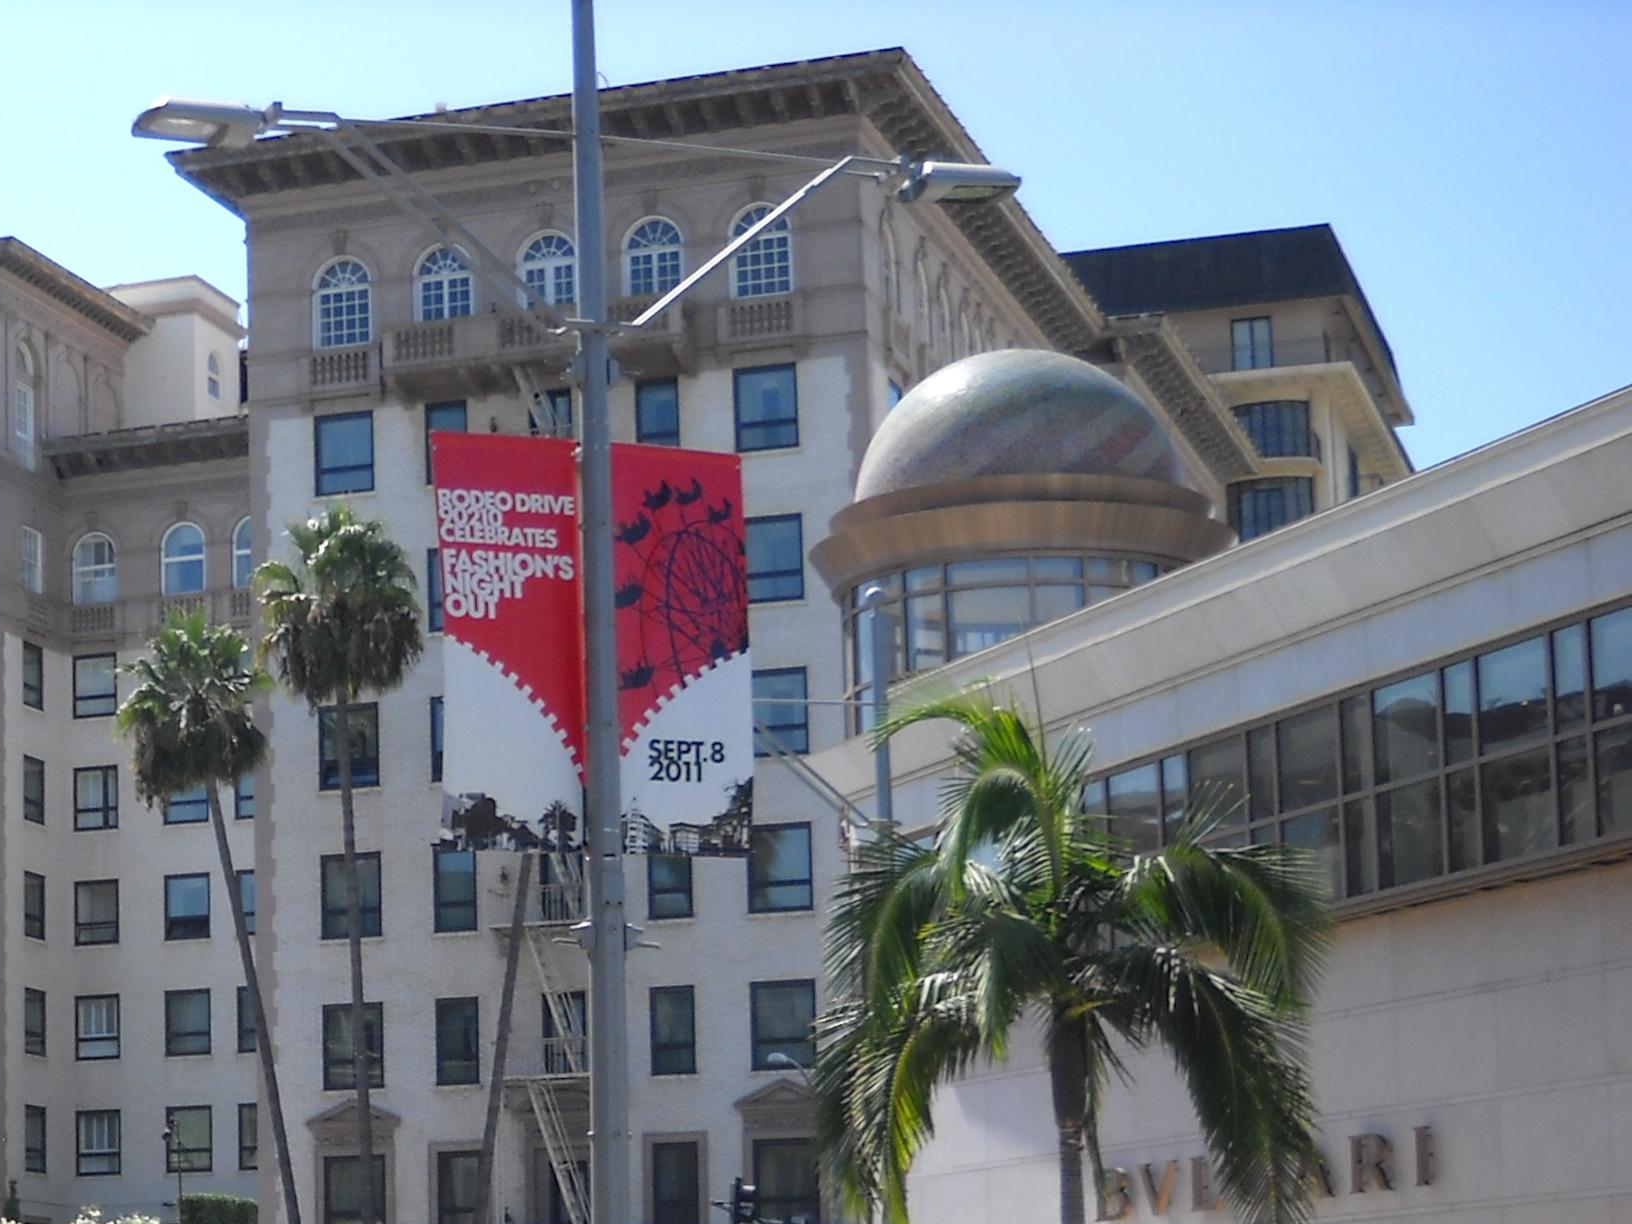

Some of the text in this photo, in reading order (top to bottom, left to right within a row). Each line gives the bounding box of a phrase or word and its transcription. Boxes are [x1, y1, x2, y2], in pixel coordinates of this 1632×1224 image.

[437, 489, 575, 516] RODEO DRIVE
[438, 505, 503, 526] 90210
[440, 522, 558, 549] CELEBRATES
[442, 548, 574, 581] FASHION'S
[444, 571, 525, 599] NIGHT
[445, 593, 499, 620] OUT
[649, 760, 702, 782] 2011
